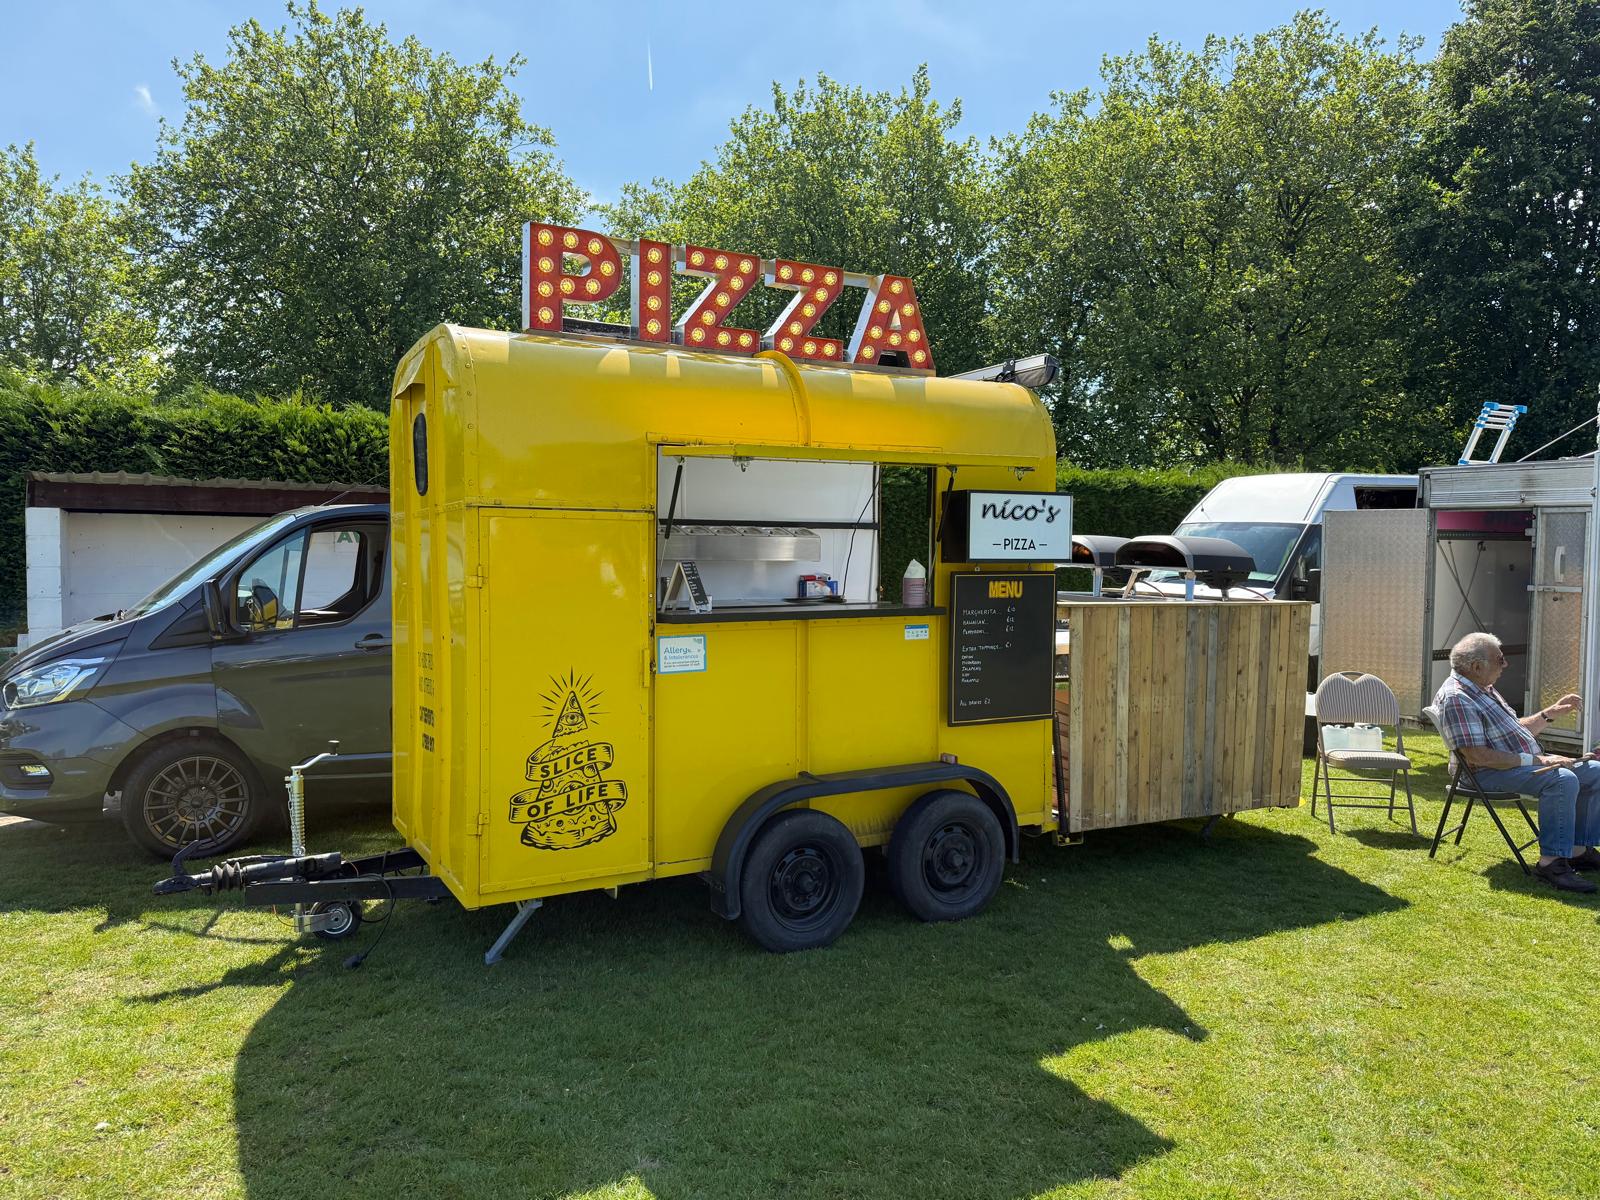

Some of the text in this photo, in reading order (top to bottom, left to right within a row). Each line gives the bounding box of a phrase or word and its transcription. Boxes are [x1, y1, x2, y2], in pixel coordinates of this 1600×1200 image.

[522, 221, 932, 369] PIZZA
[982, 498, 1061, 523] nico's
[1003, 538, 1036, 550] PIZZA
[988, 581, 1023, 598] MENU
[540, 748, 597, 778] SLICE
[527, 783, 608, 818] OF LIFE
